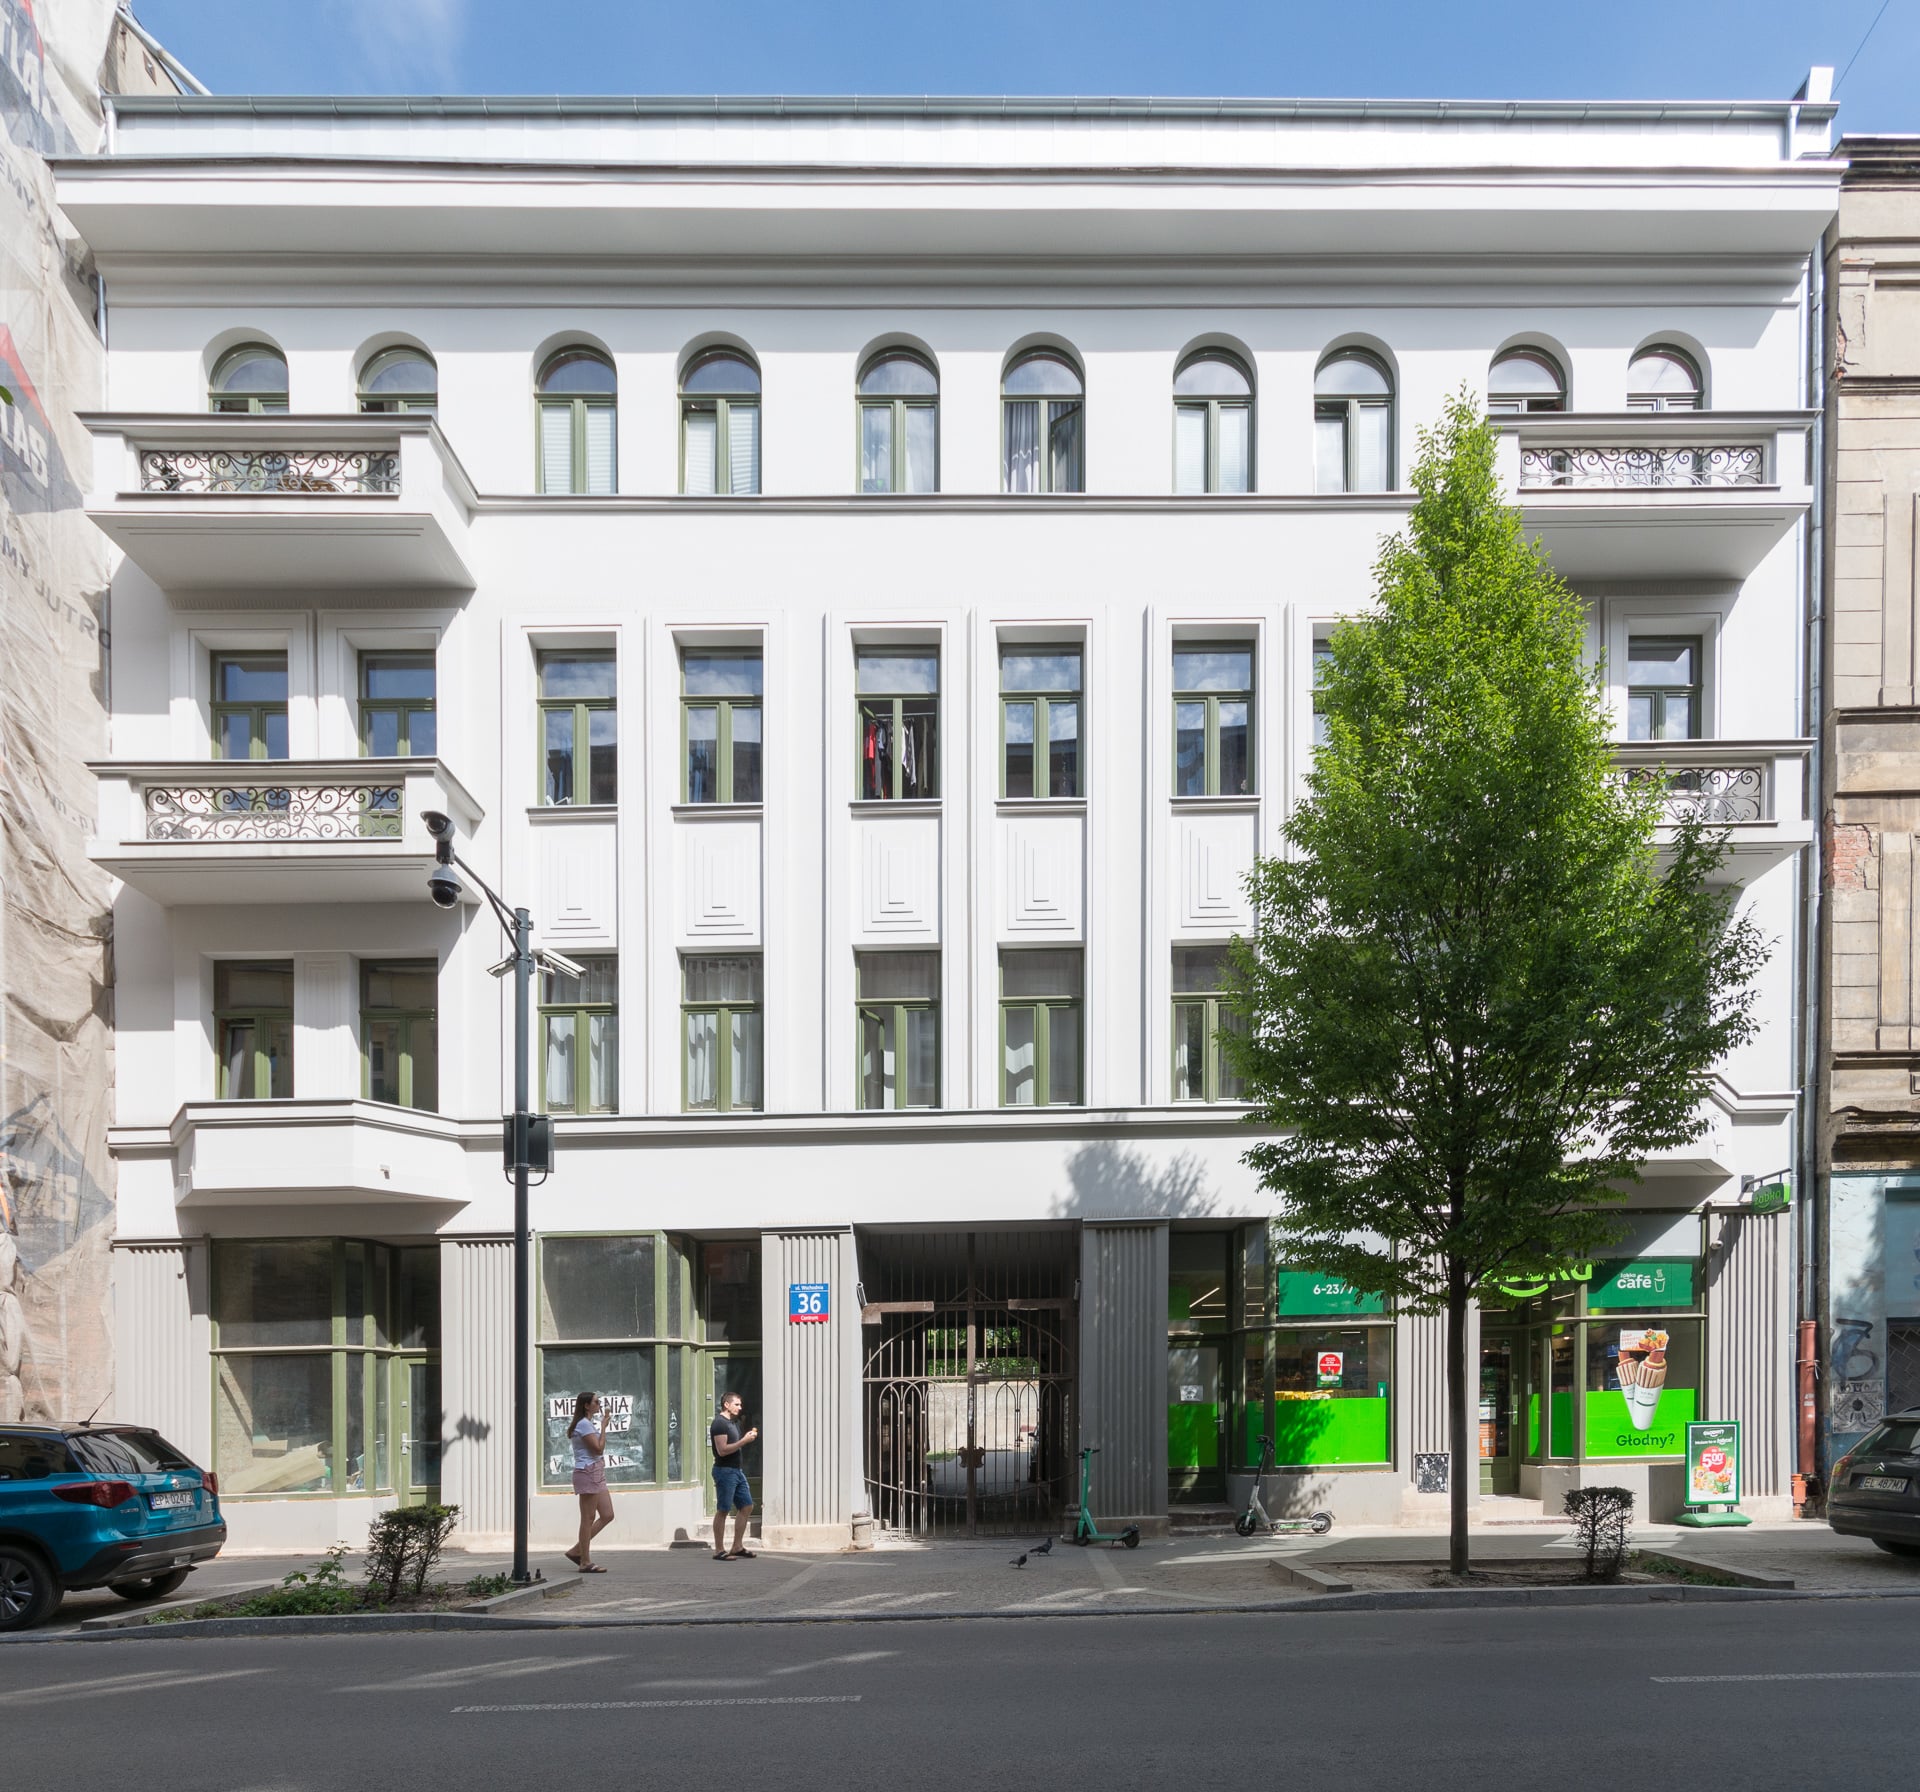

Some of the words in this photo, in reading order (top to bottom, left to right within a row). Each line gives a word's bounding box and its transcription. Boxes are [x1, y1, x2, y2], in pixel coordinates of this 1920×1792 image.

[1617, 1274, 1652, 1289] café
[798, 1293, 821, 1313] 36
[1616, 1433, 1675, 1448] Głodny?
[1864, 1477, 1875, 1488] EL
